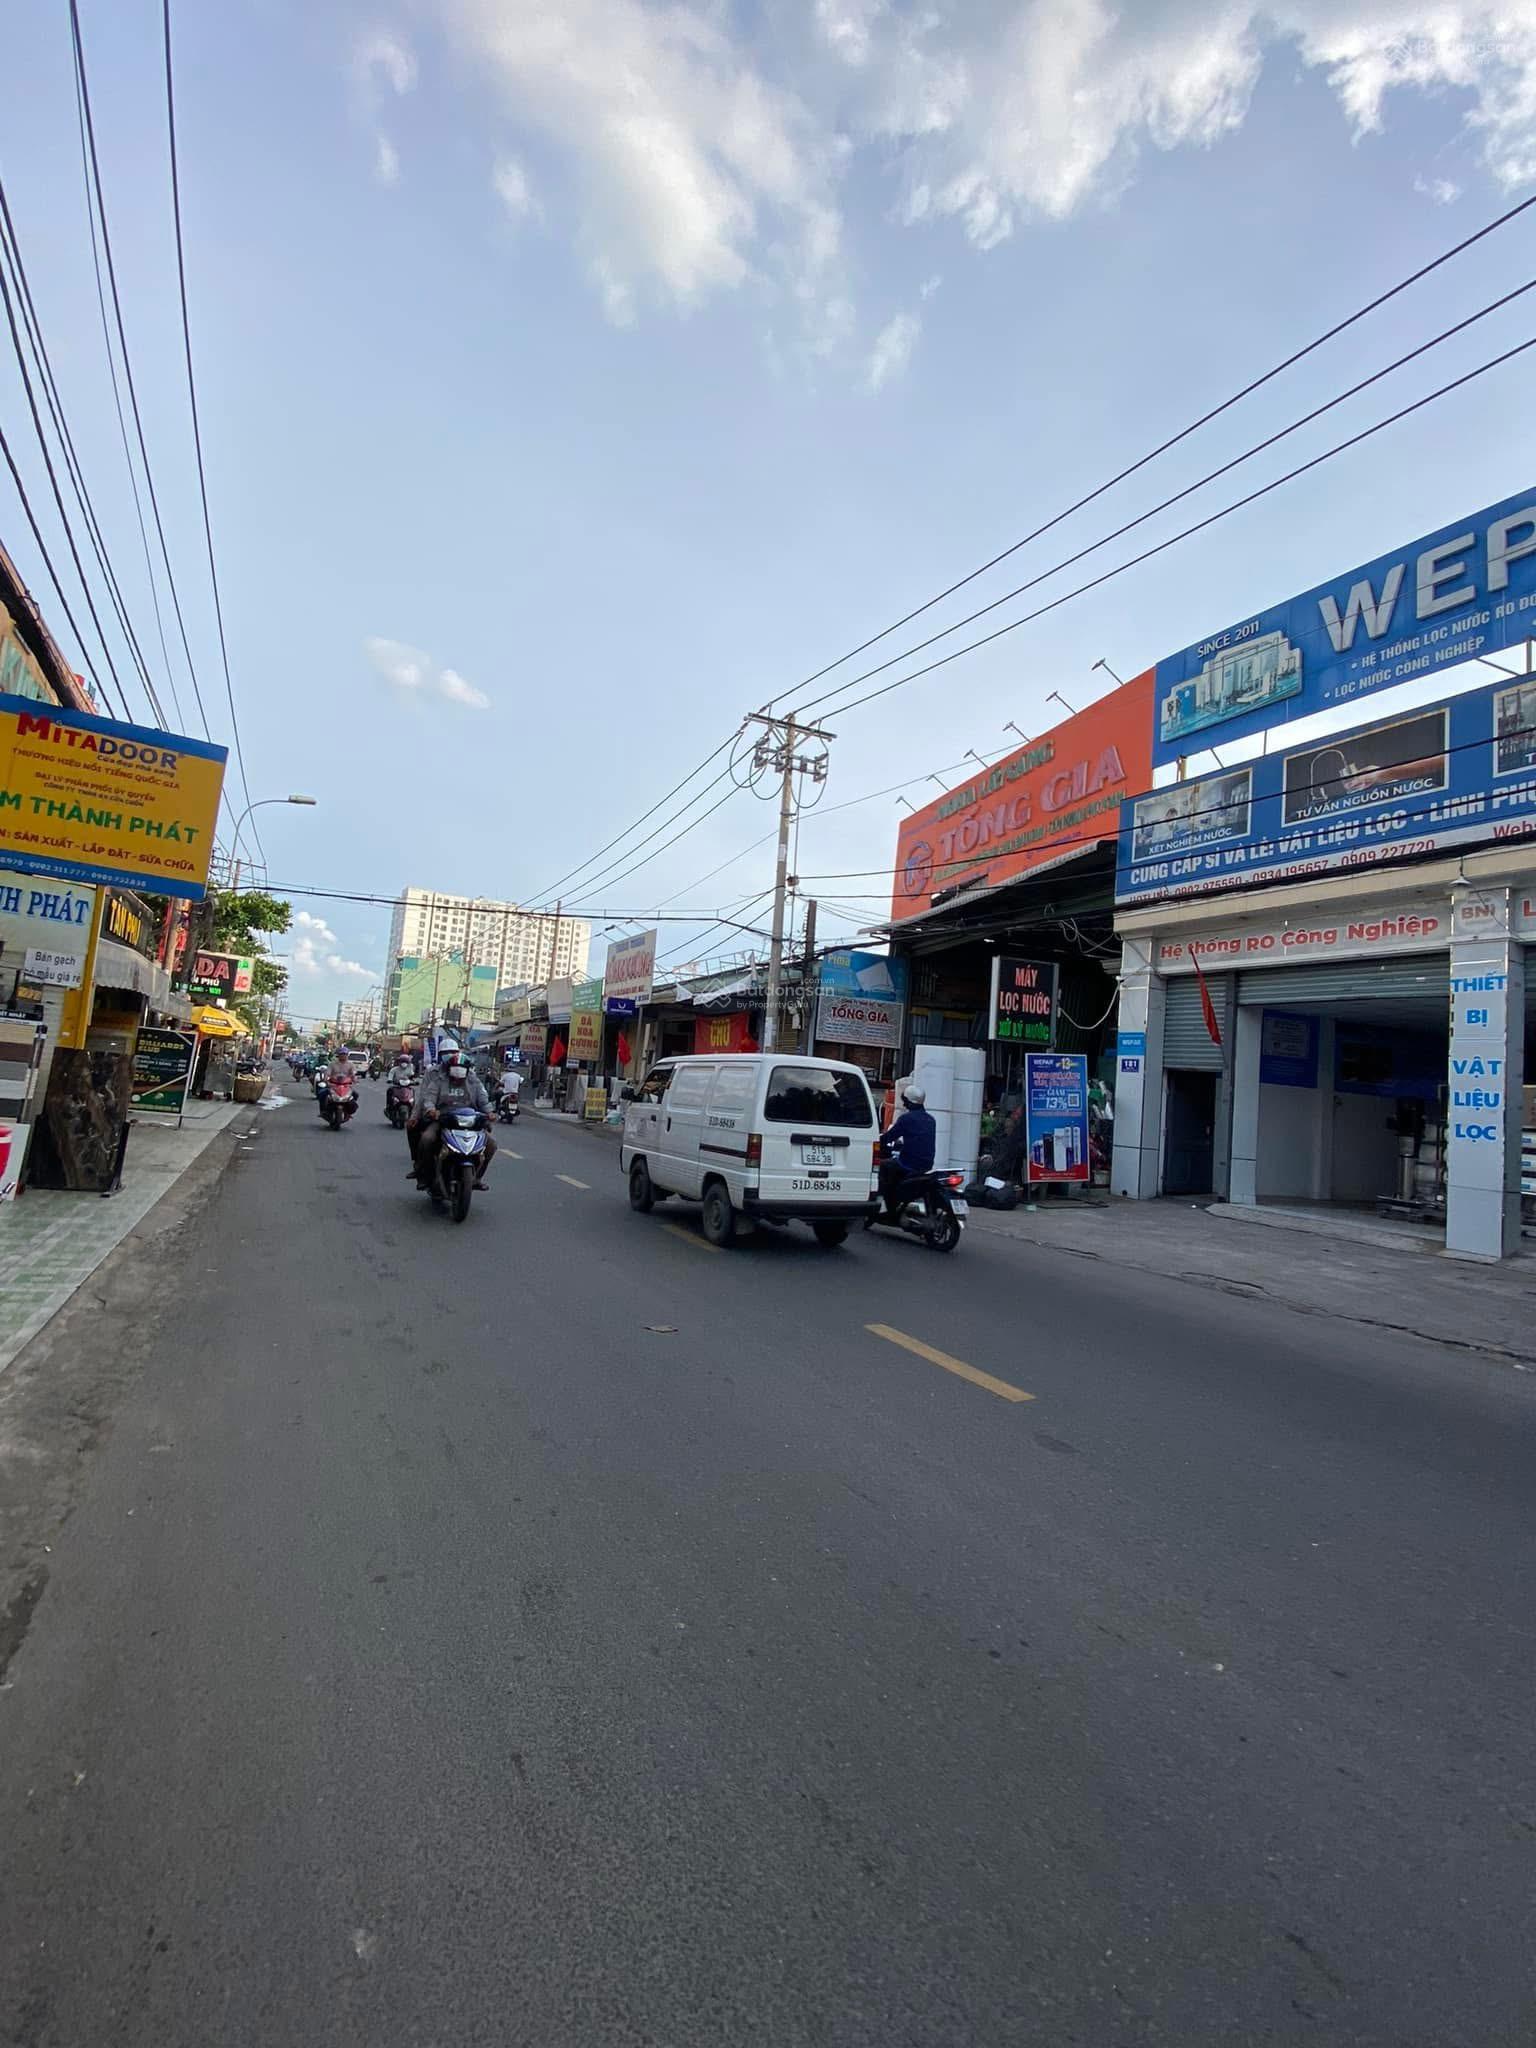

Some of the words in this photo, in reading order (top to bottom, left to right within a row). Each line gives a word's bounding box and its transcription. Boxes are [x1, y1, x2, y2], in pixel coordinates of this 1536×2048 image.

[1197, 634, 1232, 658] SINCE
[1234, 620, 1260, 643] 2011
[1423, 625, 1449, 649] LỌC
[1451, 610, 1490, 638] NƯỚC
[1334, 680, 1357, 700] LỌC
[1358, 666, 1392, 691] NƯỚC
[1395, 652, 1430, 680] CÔNG
[1434, 634, 1486, 666] NGHIỆP
[16, 711, 178, 770] MITADOOR
[13, 747, 55, 762] THƯƠNG
[104, 764, 133, 781] TIẾNG
[163, 779, 181, 790] GIA
[1040, 745, 1127, 812] GIA
[1296, 804, 1315, 819] TƯ
[1315, 797, 1340, 815] VẤN
[1343, 786, 1391, 810] NGUỒN
[1393, 777, 1434, 797] NƯỚC
[30, 796, 122, 831] THÀNH
[129, 815, 199, 844] PHÁT
[1204, 826, 1233, 842] NƯỚC
[14, 830, 40, 844] SẢN
[41, 834, 74, 850] XUẤT
[82, 841, 106, 856] LẮP
[107, 847, 132, 861] ĐẶT
[139, 852, 161, 867] SỬA
[163, 856, 196, 872] CHỮA
[1130, 864, 1168, 886] CUNG
[1171, 853, 1203, 878] CẤP
[1221, 842, 1246, 866] VÀ
[1278, 829, 1313, 855] VẬT
[1317, 817, 1360, 846] LIỆU
[1365, 808, 1408, 838] LỌC
[1430, 791, 1485, 823] LINH
[27, 890, 89, 924] PHÁT
[1160, 943, 1183, 960] Hệ
[1187, 935, 1241, 957] thống
[1246, 934, 1275, 952] RO
[1281, 927, 1338, 949] Công
[1348, 914, 1439, 941] Nghiệp
[54, 954, 76, 966] gạch
[1015, 965, 1038, 988] MÁY
[1452, 971, 1507, 992] THIẾT
[868, 1011, 889, 1024] GIA
[1000, 991, 1019, 1015] LỌC
[1022, 992, 1050, 1015] NƯỚC
[1466, 1008, 1488, 1026] BỊ
[1453, 1056, 1502, 1079] VẬT
[1453, 1088, 1500, 1110] LIỆU
[1455, 1123, 1497, 1143] LỌC
